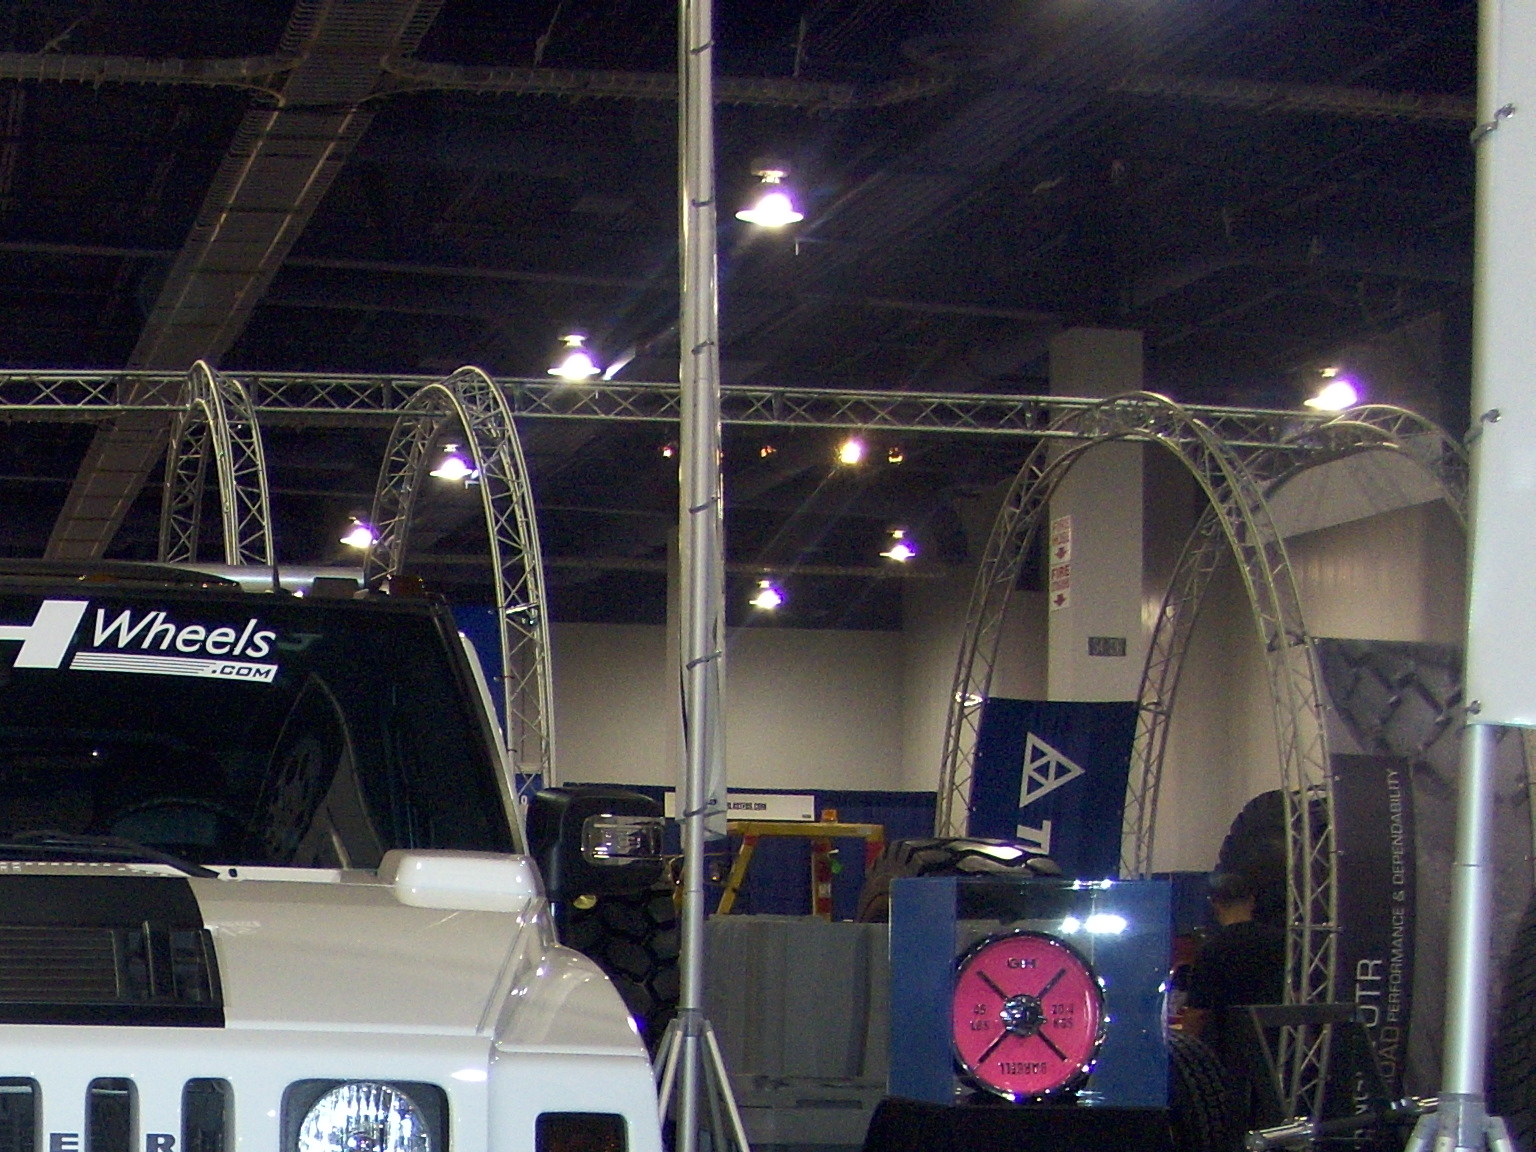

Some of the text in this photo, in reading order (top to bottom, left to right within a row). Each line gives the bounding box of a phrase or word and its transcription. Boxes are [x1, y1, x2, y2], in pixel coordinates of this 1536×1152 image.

[92, 607, 277, 659] Wheels
[1387, 769, 1405, 885] DEPENDABILITY
[1386, 907, 1405, 1023] PERFORMANCE
